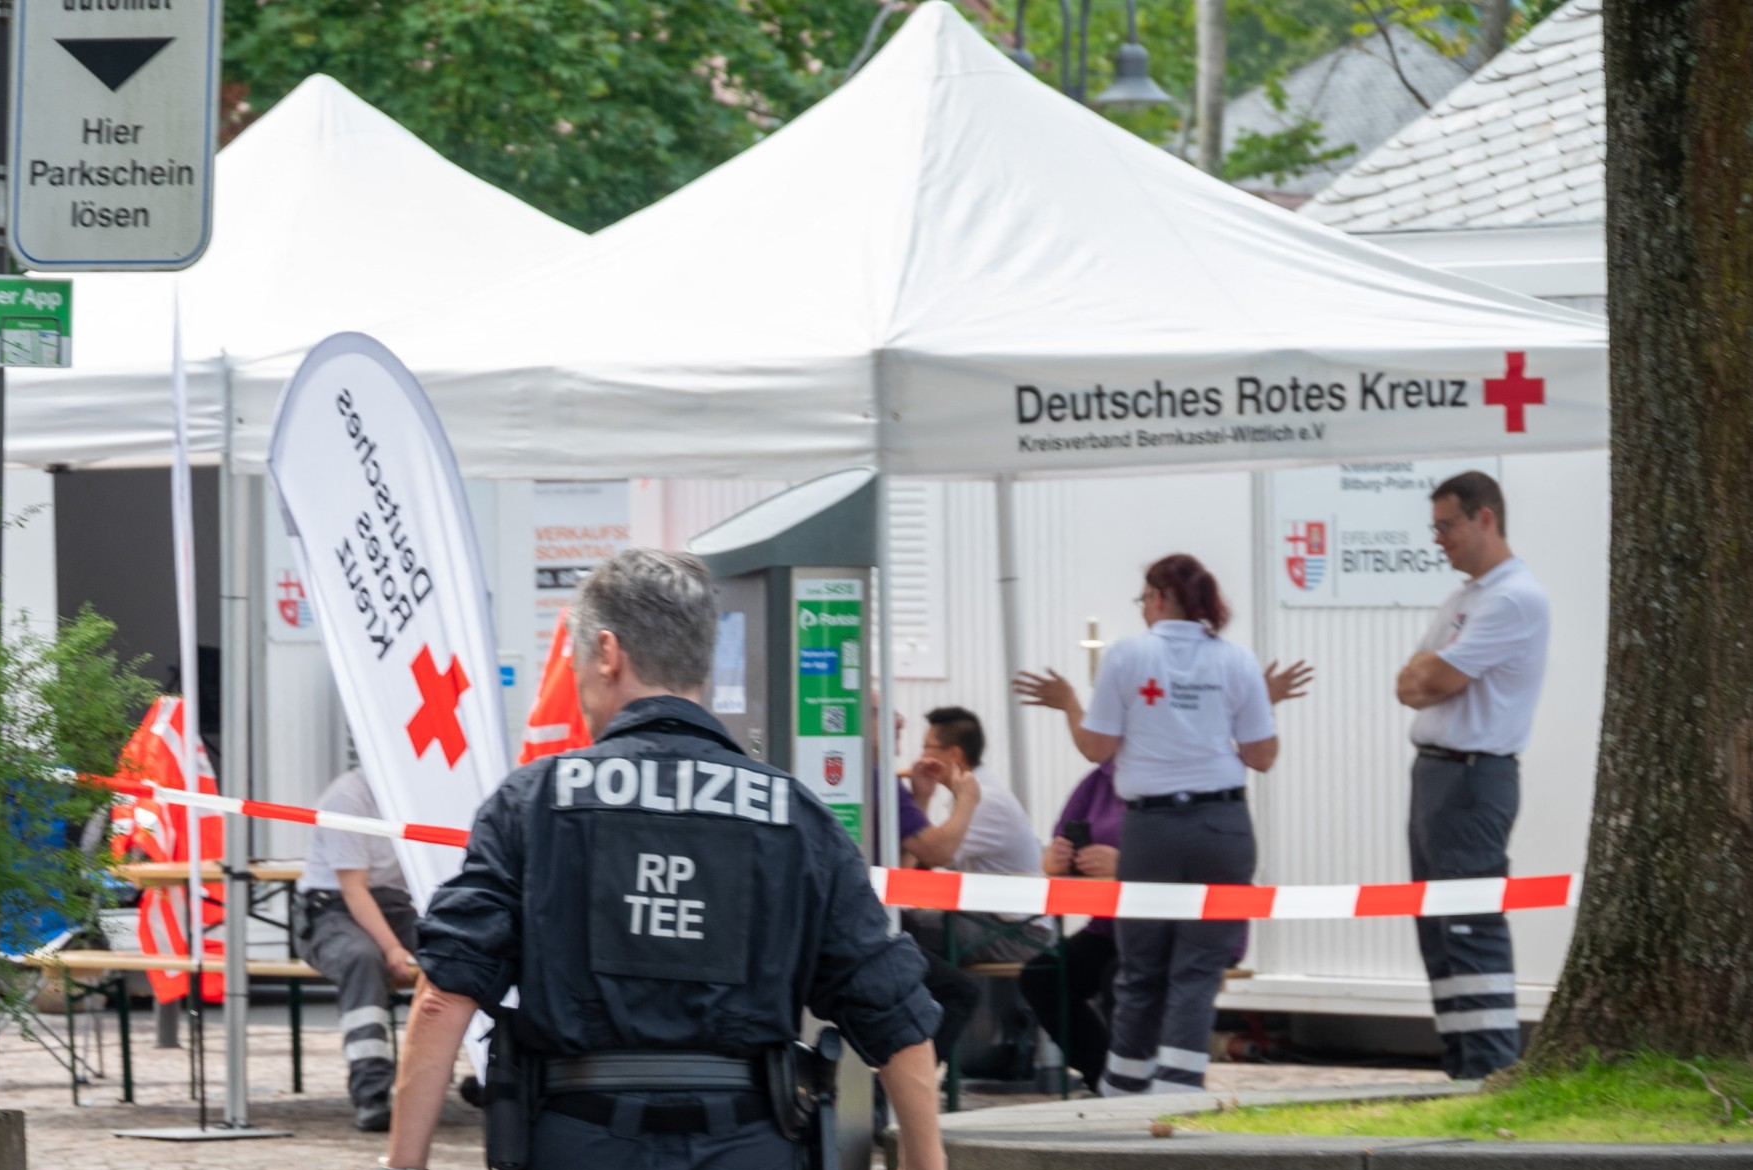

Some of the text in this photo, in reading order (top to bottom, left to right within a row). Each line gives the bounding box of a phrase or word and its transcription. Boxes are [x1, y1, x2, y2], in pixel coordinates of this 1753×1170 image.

[82, 118, 143, 145] Hier
[29, 159, 195, 187] Parkschein
[70, 200, 151, 228] lösen
[20, 287, 64, 312] App
[1014, 371, 1469, 425] Deutsches Rotes Kreuz
[1018, 428, 1131, 453] Kreisverband
[1136, 422, 1294, 448] Bernkastel-Wittlich
[1341, 549, 1451, 574] BITBURG-P
[555, 757, 790, 826] POLIZEI
[636, 852, 696, 895] RP
[623, 894, 706, 940] TEE
